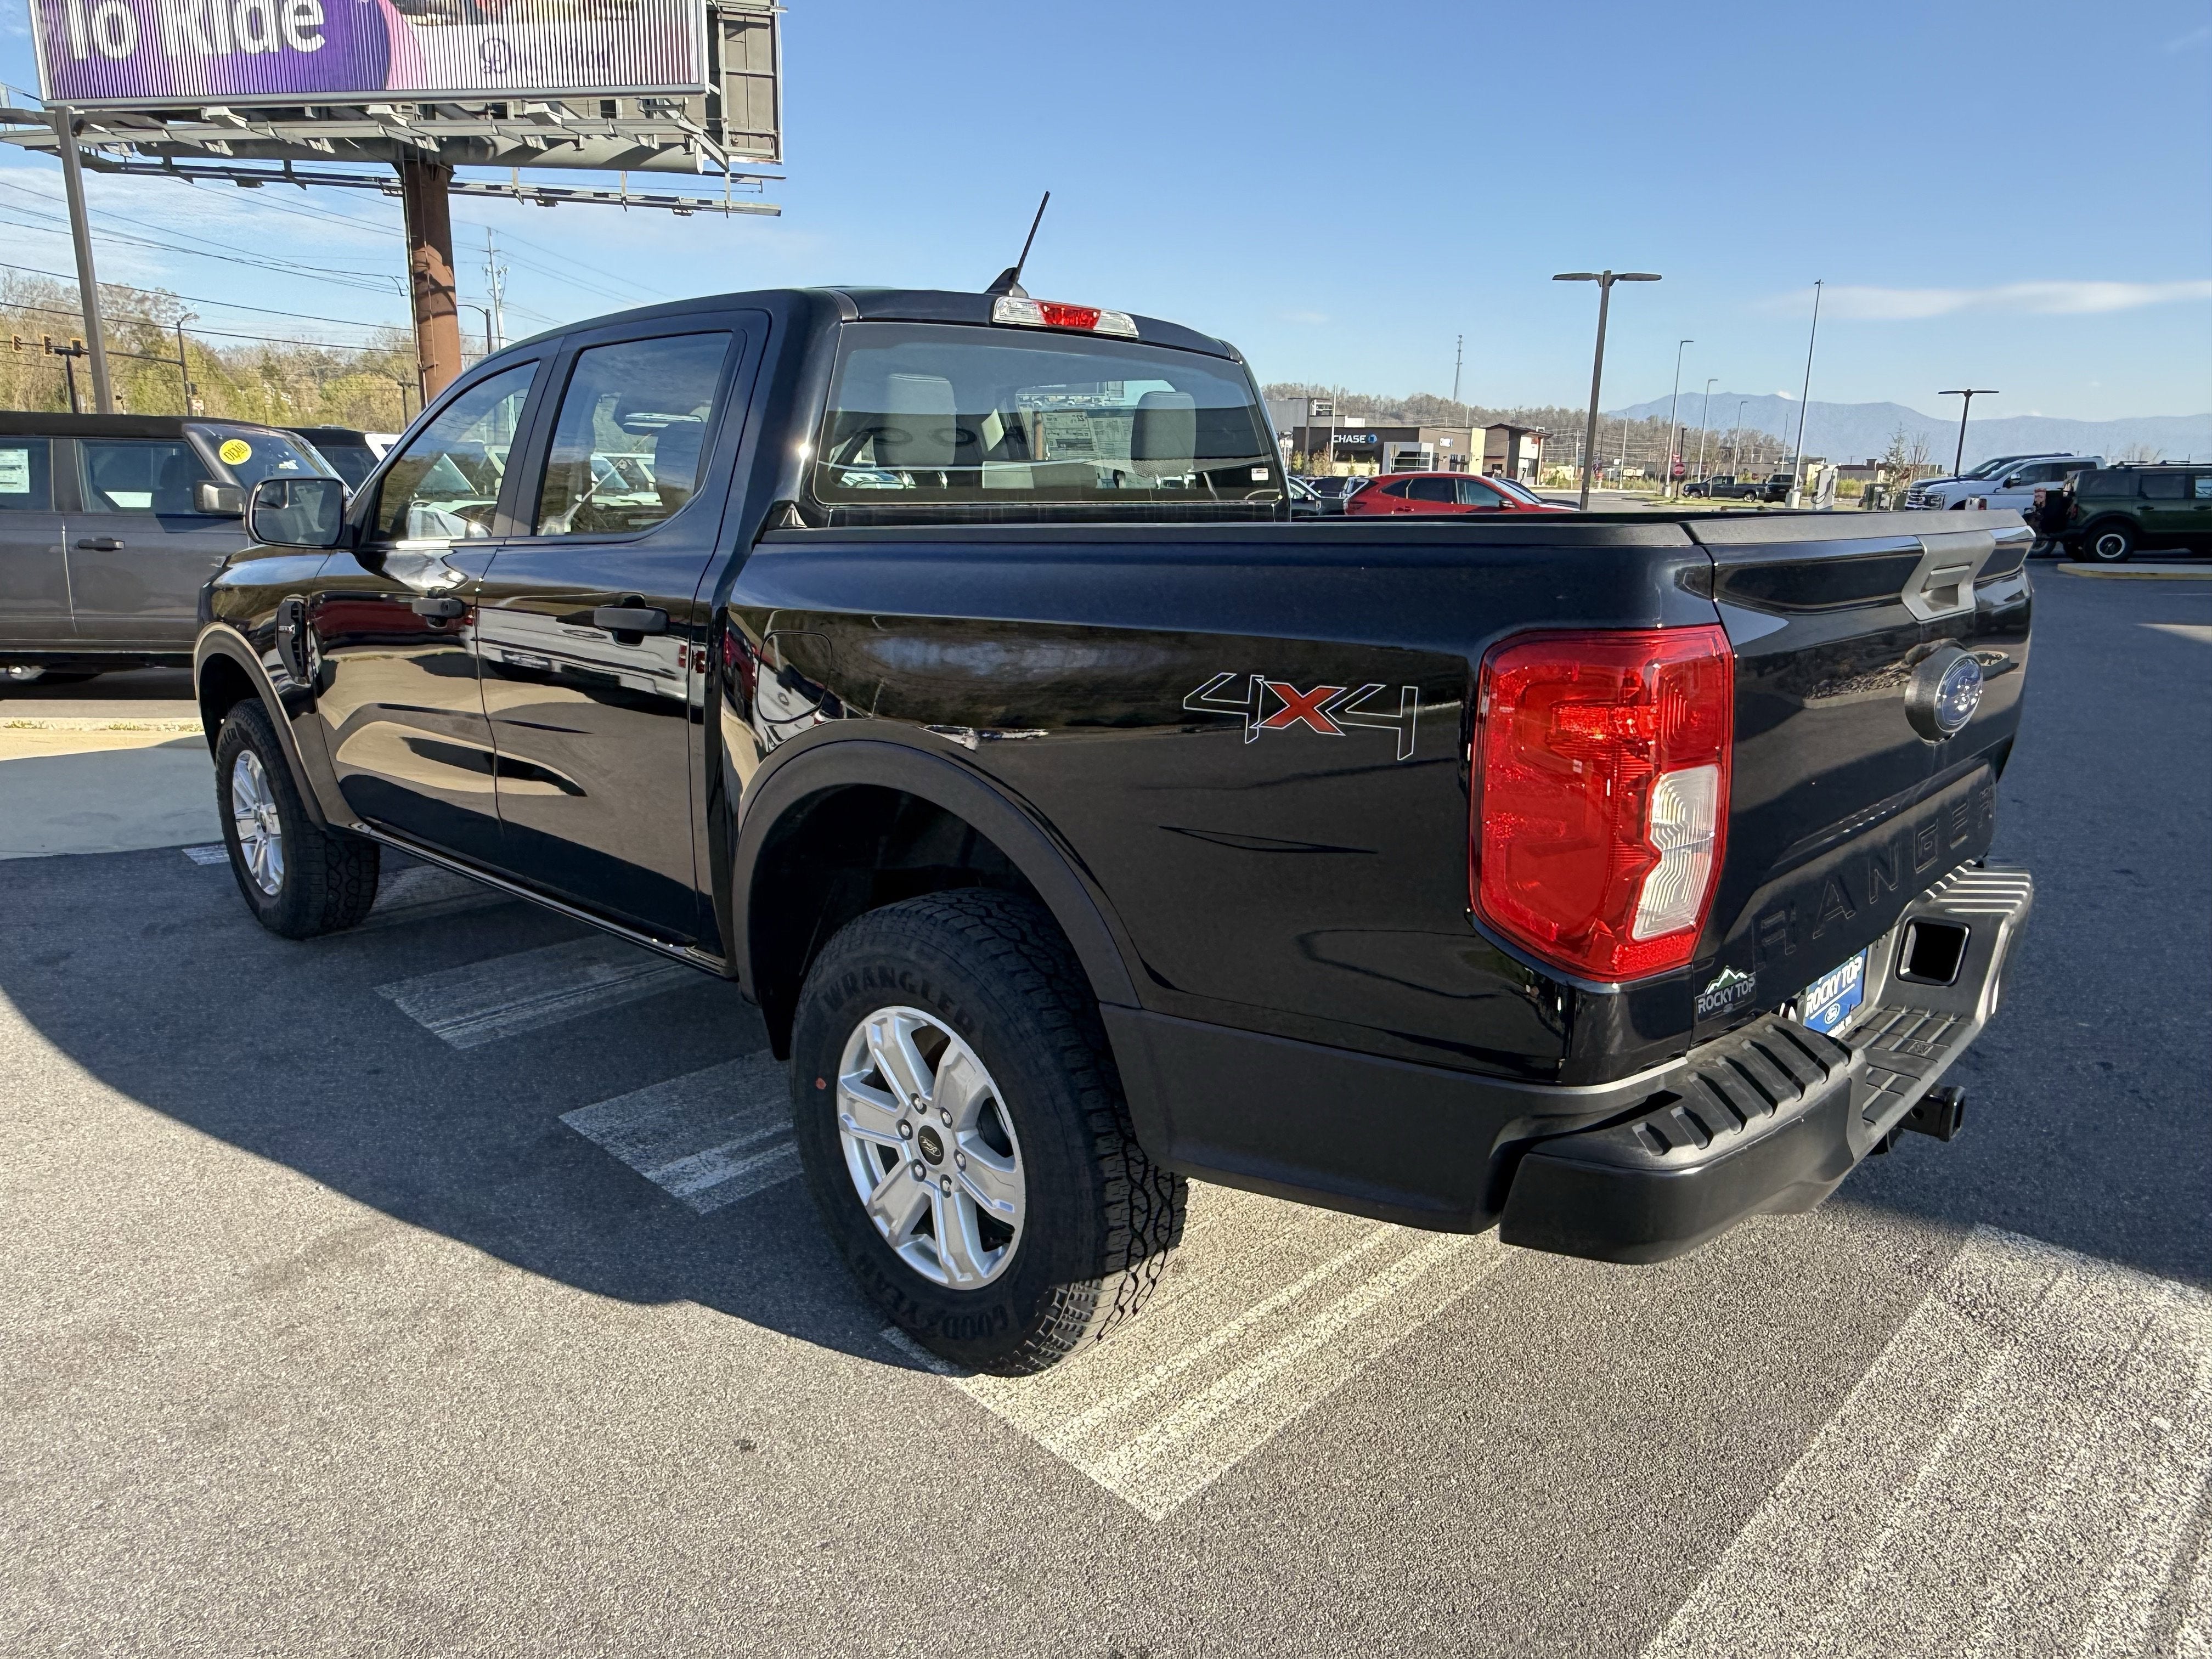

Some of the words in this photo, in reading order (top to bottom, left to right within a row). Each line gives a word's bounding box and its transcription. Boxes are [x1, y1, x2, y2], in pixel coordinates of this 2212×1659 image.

[1334, 435, 1367, 443] CHASE
[1751, 786, 1993, 975] RANGER
[822, 966, 975, 1036] WRANGLER
[1698, 984, 1734, 1014] ROCKY
[1735, 976, 1756, 997] TOP
[1805, 970, 1842, 1018] ROCKY
[1841, 956, 1863, 988] TOP
